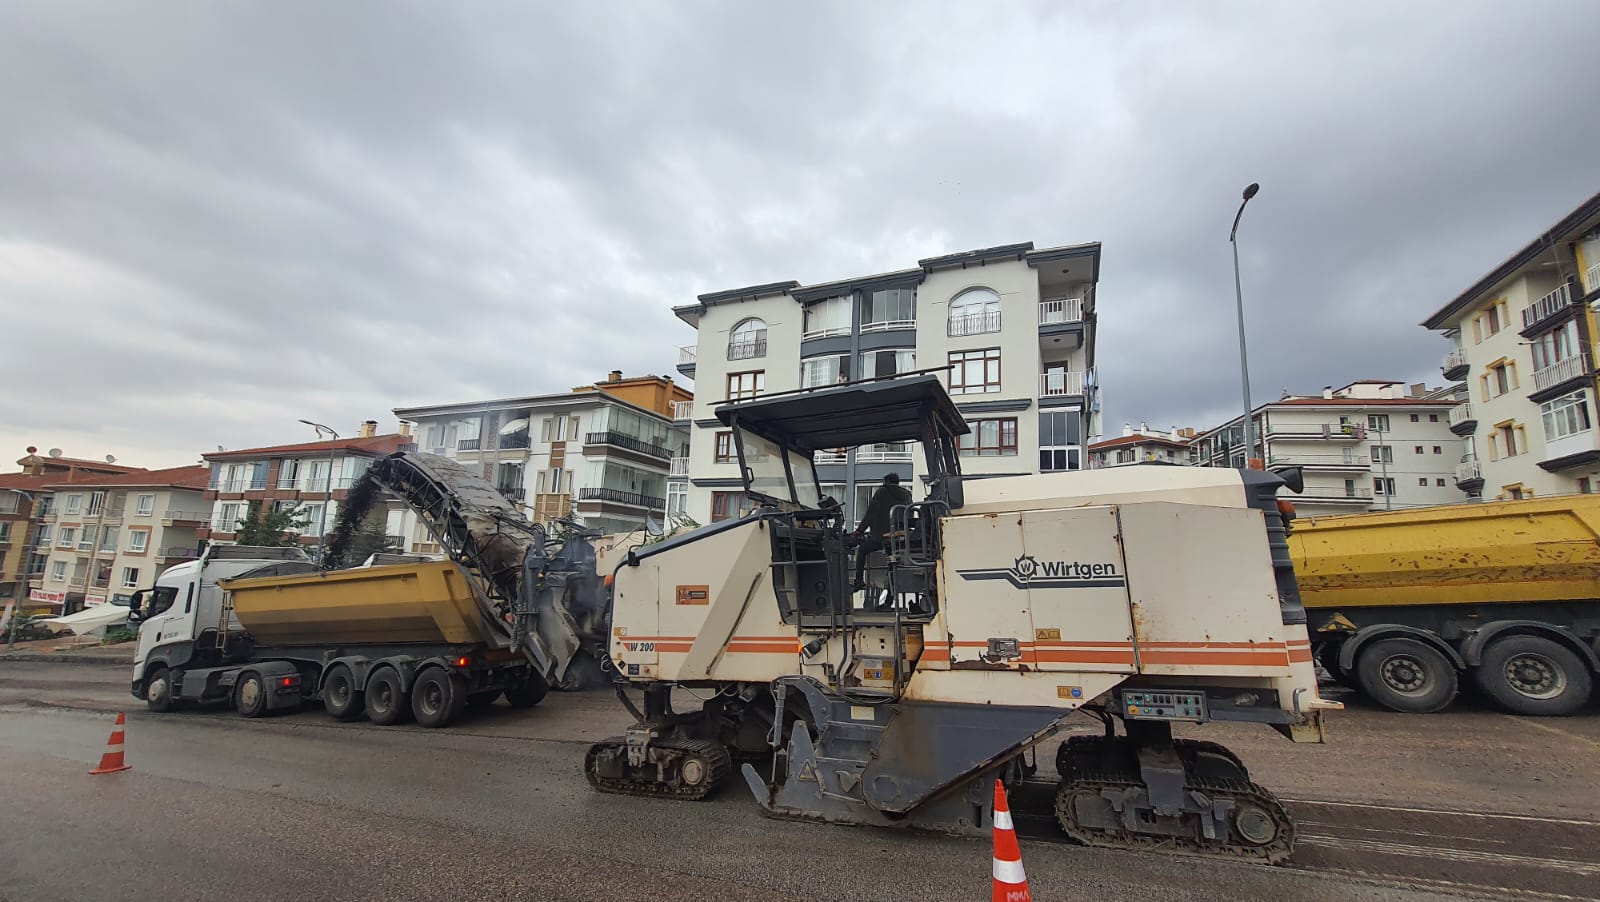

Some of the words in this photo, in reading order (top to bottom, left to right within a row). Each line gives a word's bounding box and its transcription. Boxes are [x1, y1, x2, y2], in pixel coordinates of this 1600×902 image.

[1042, 562, 1115, 579] Wirtgen
[630, 643, 638, 652] W
[639, 643, 654, 652] 200
